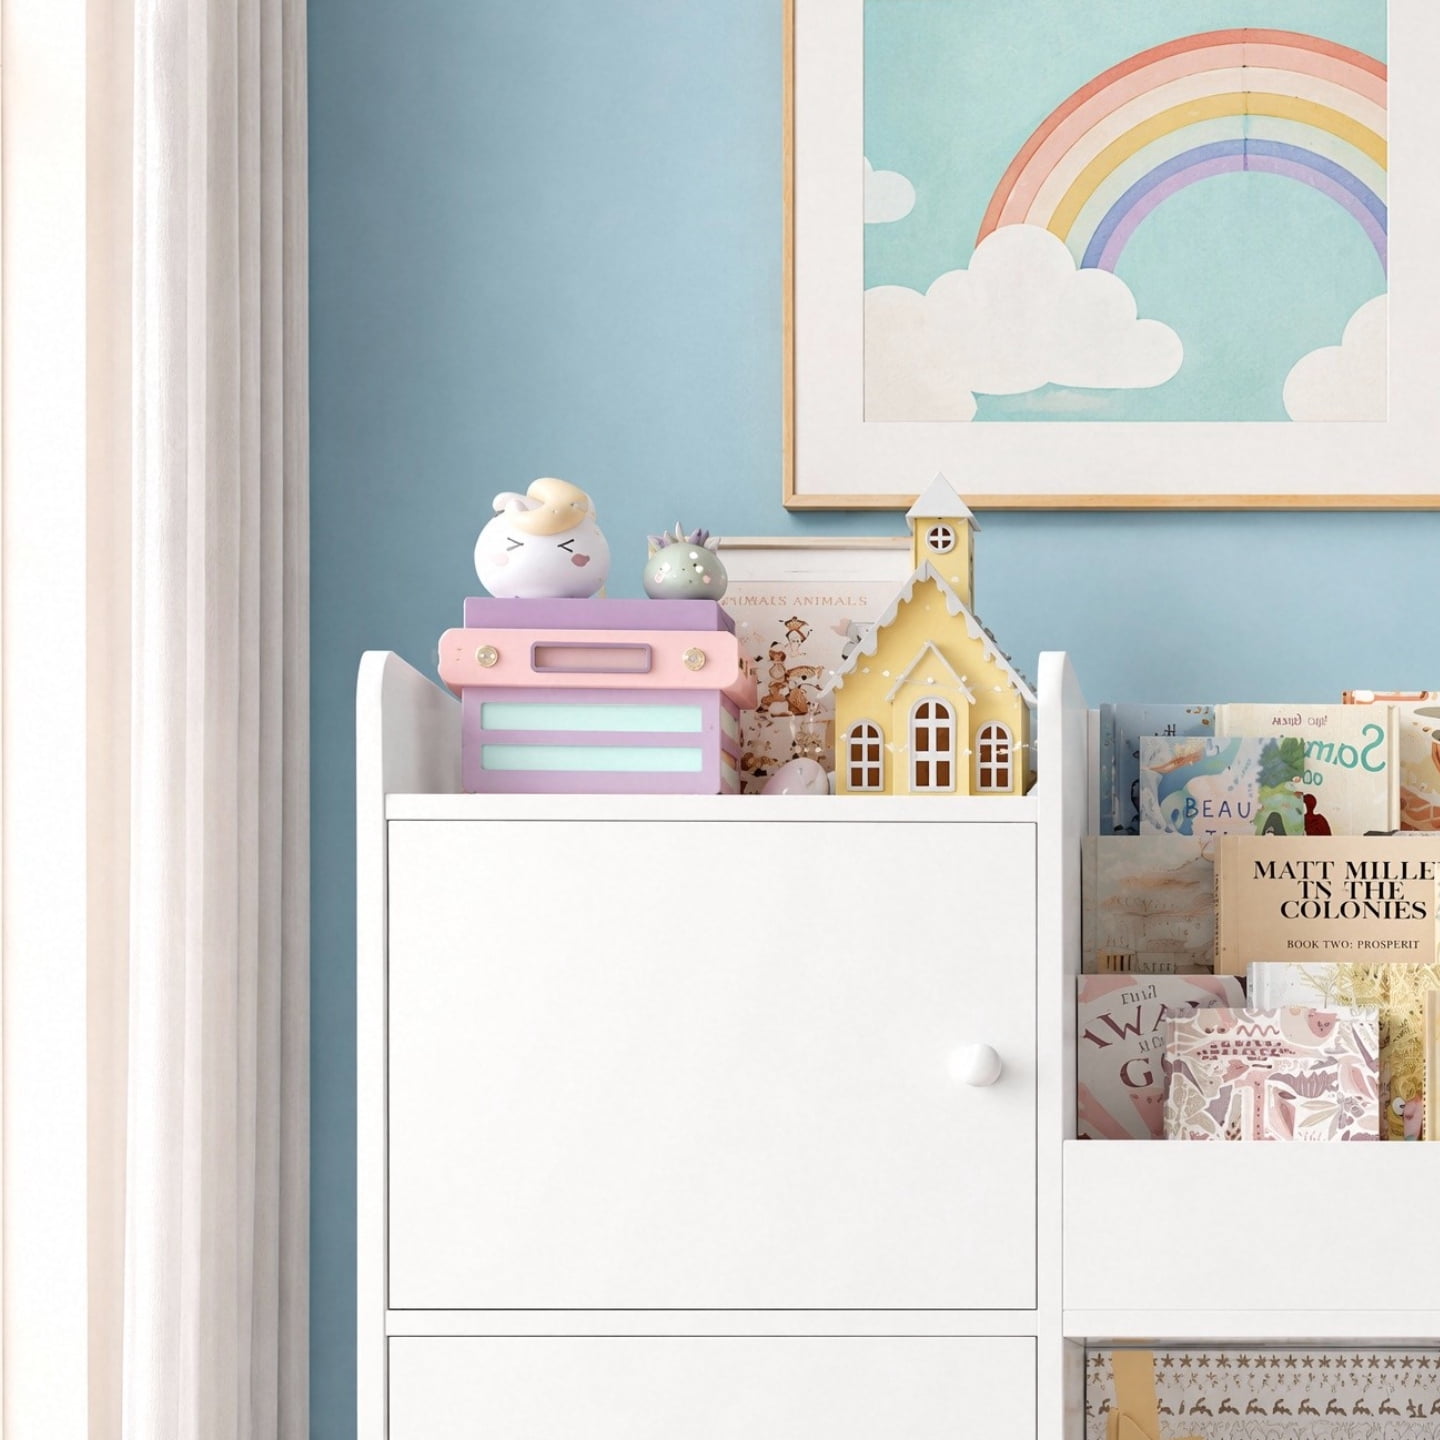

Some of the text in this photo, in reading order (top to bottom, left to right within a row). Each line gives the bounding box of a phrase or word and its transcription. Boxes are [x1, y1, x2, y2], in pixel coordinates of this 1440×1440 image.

[793, 596, 868, 606] ANIMALS
[1185, 797, 1251, 820] BEAU
[1253, 860, 1335, 880] MATT
[1343, 880, 1405, 900] THE
[1280, 900, 1428, 920] COLONIES
[1287, 939, 1420, 950] BOOK TWO: PROSPERIT
